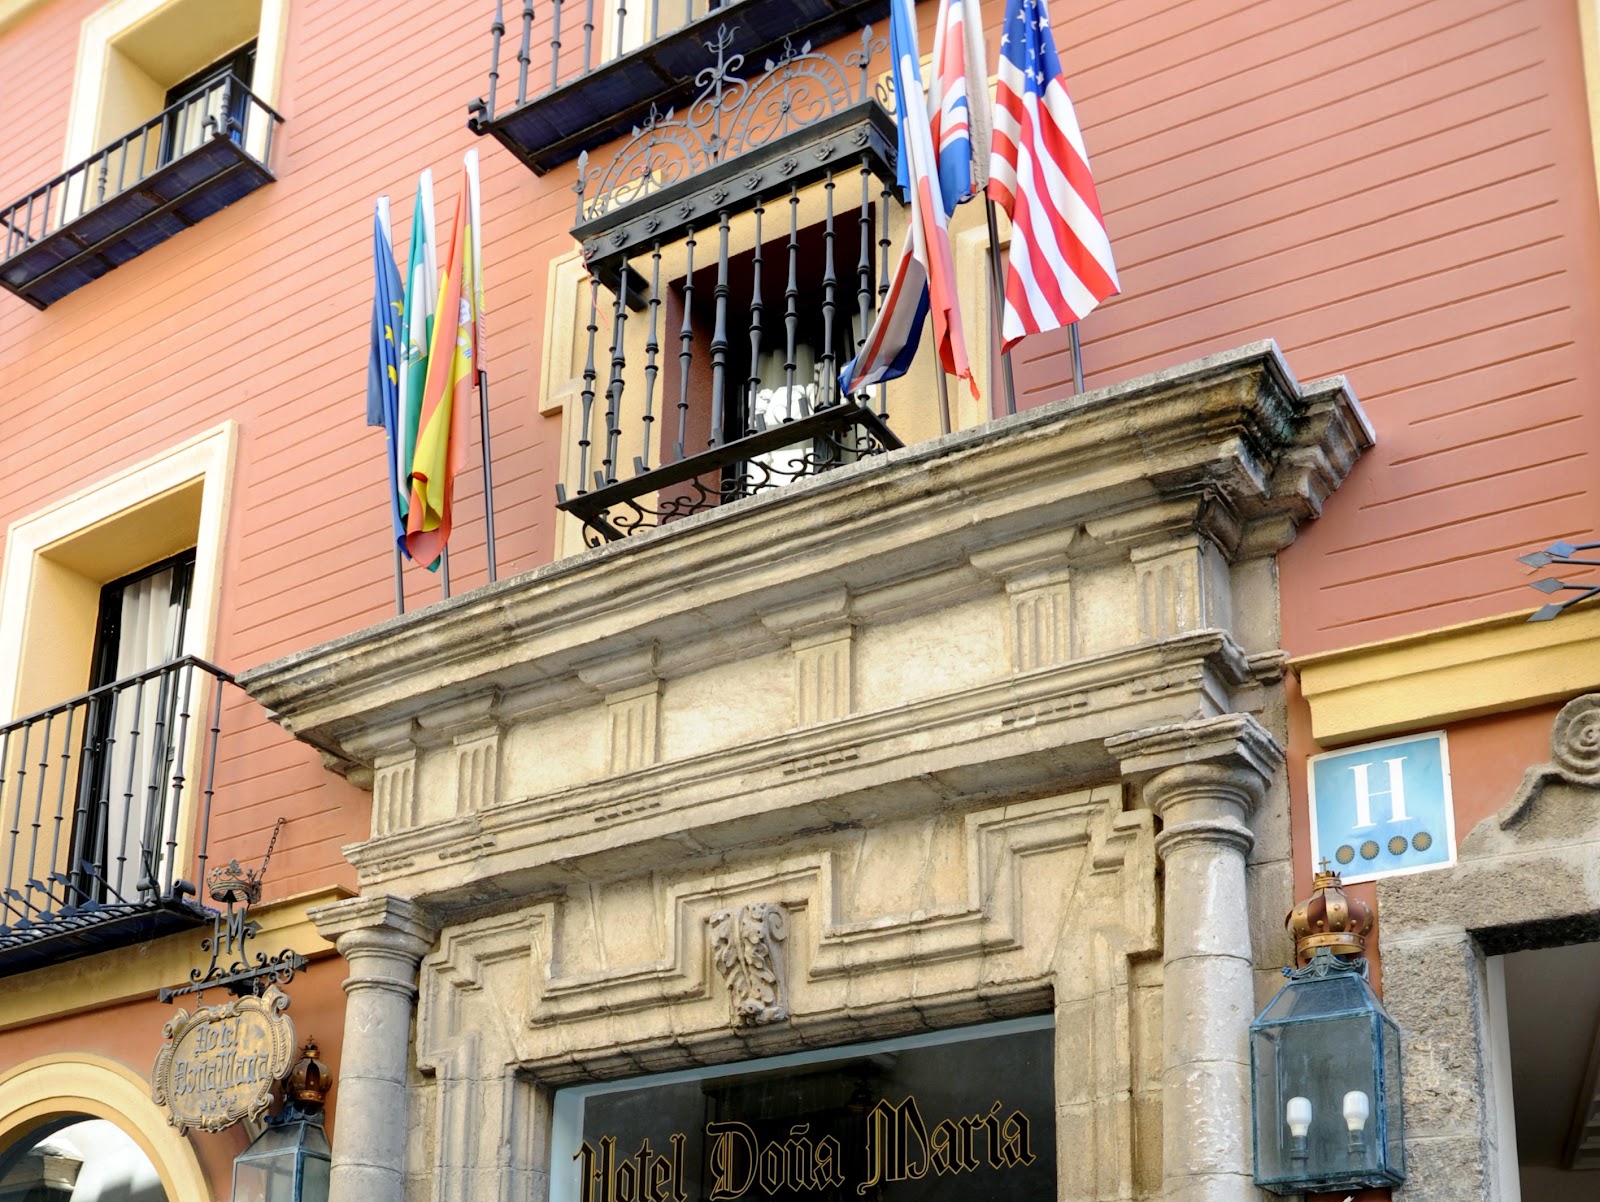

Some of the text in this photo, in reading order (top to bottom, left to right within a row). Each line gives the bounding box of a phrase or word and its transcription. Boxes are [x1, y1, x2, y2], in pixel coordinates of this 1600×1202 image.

[1348, 756, 1413, 829] H
[194, 1018, 241, 1058] Hotel
[706, 1121, 846, 1201] Doña
[856, 1095, 1037, 1196] María
